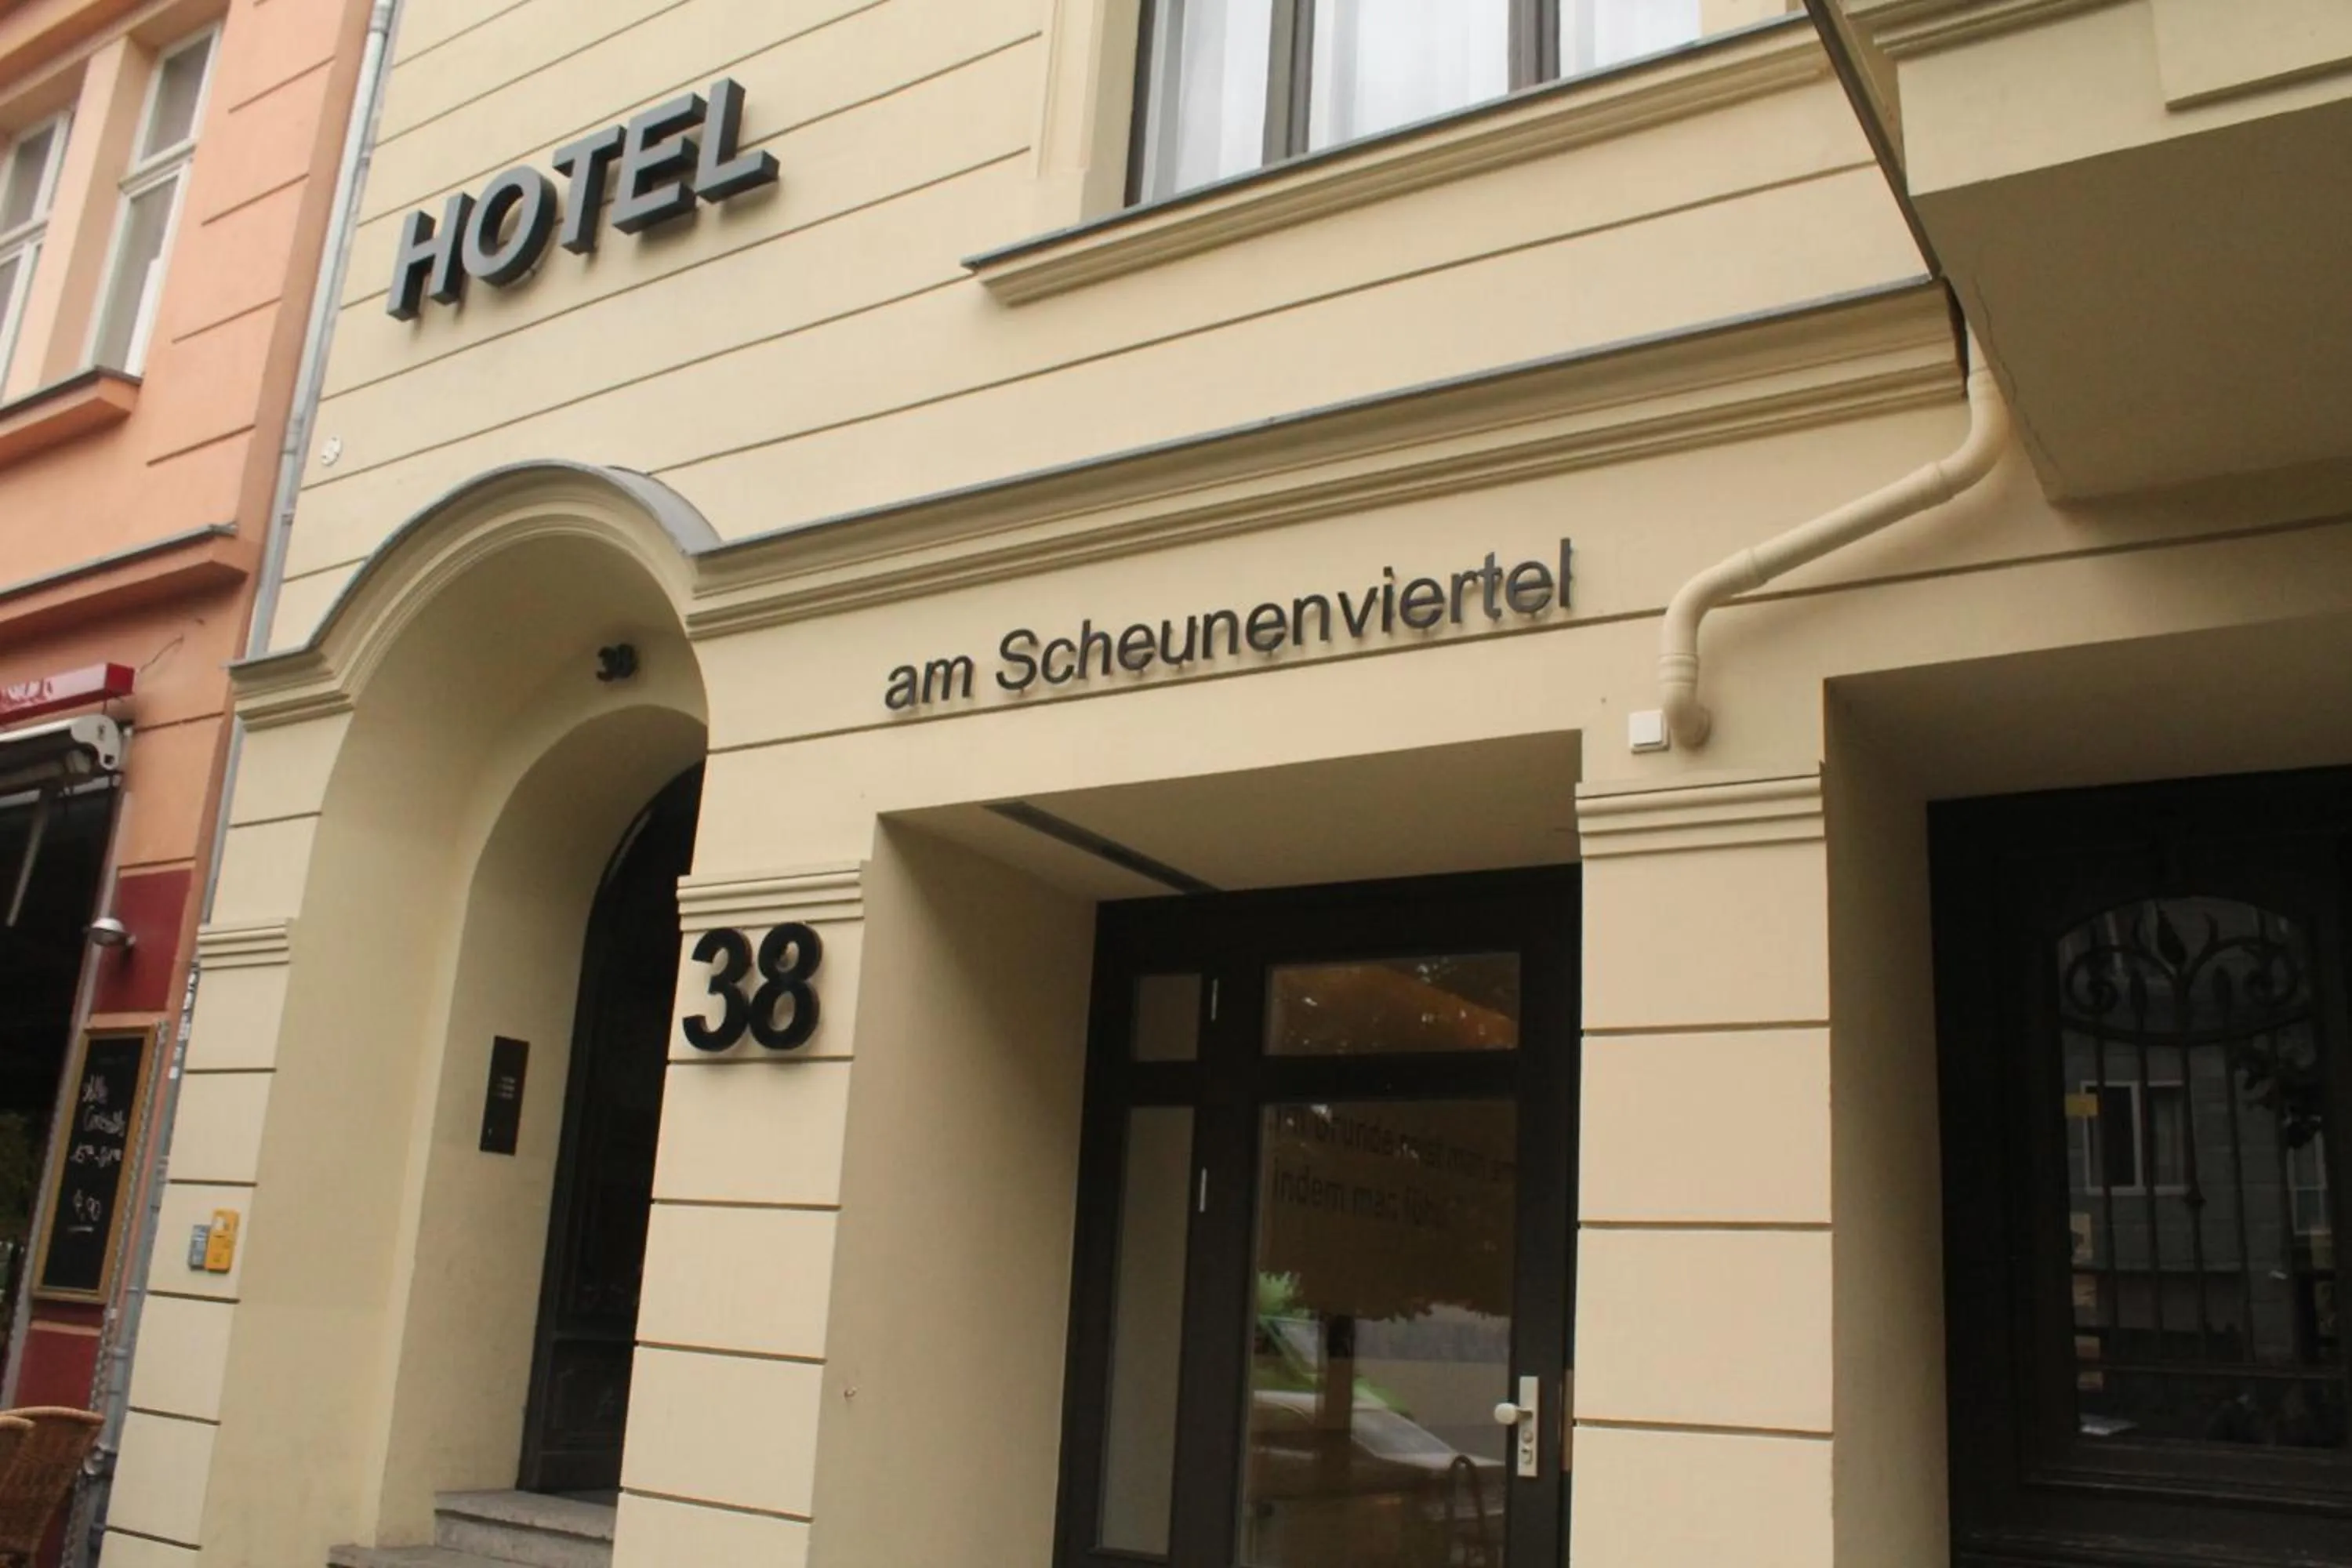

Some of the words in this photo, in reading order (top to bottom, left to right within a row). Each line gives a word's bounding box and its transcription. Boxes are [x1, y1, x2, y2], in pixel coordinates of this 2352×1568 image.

[387, 77, 780, 321] HOTEL
[884, 653, 974, 712] am
[996, 537, 1571, 692] Scheunenviertel
[682, 922, 822, 1051] 38
